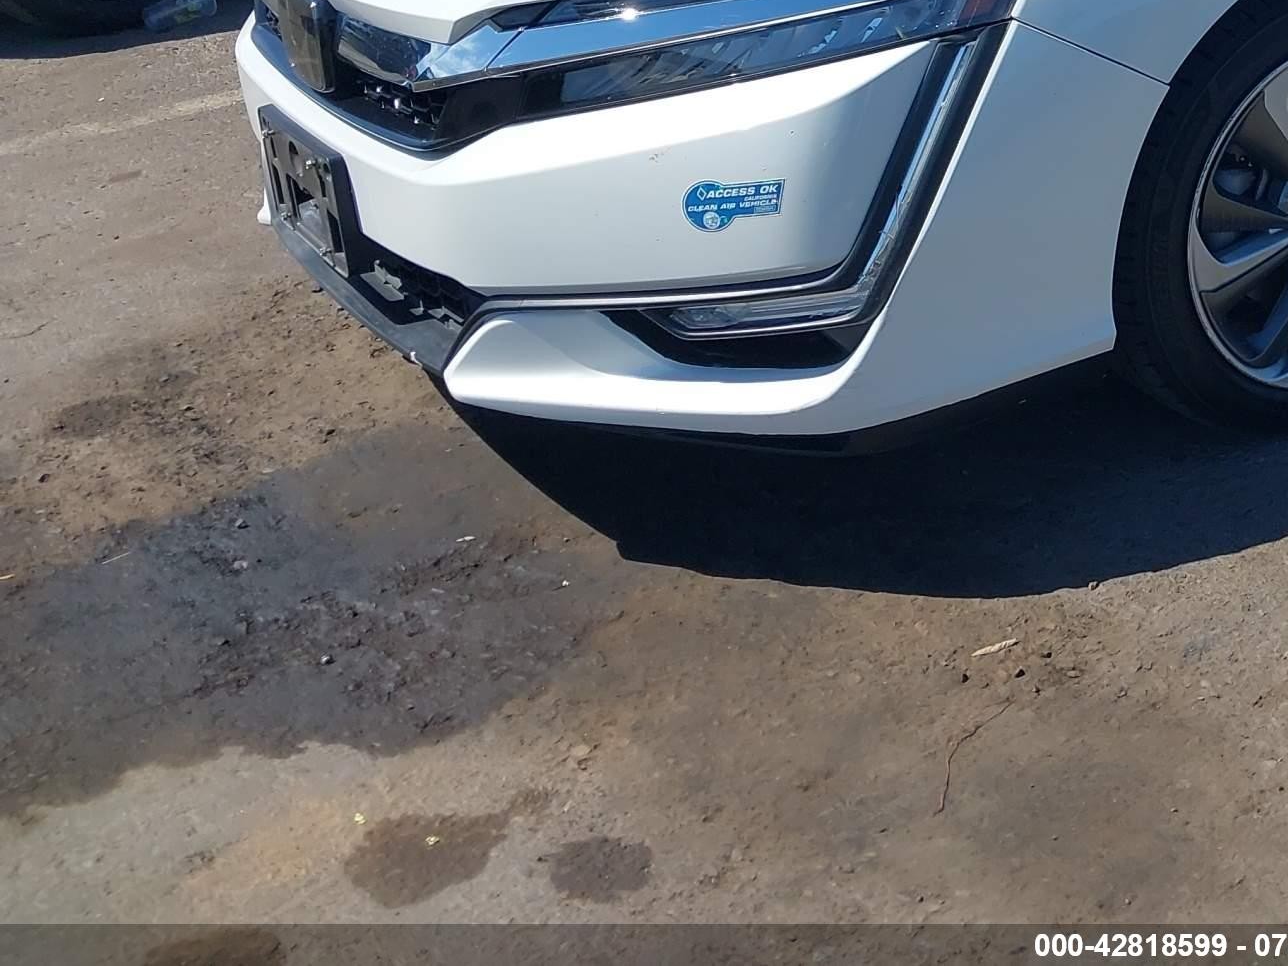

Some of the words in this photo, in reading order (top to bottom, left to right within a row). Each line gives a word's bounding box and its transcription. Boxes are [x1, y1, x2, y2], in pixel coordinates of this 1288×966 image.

[706, 186, 756, 199] ACCESS
[760, 184, 779, 194] OK
[687, 204, 718, 212] CLEAN
[720, 202, 736, 210] AIR
[740, 199, 778, 208] VEHICLE
